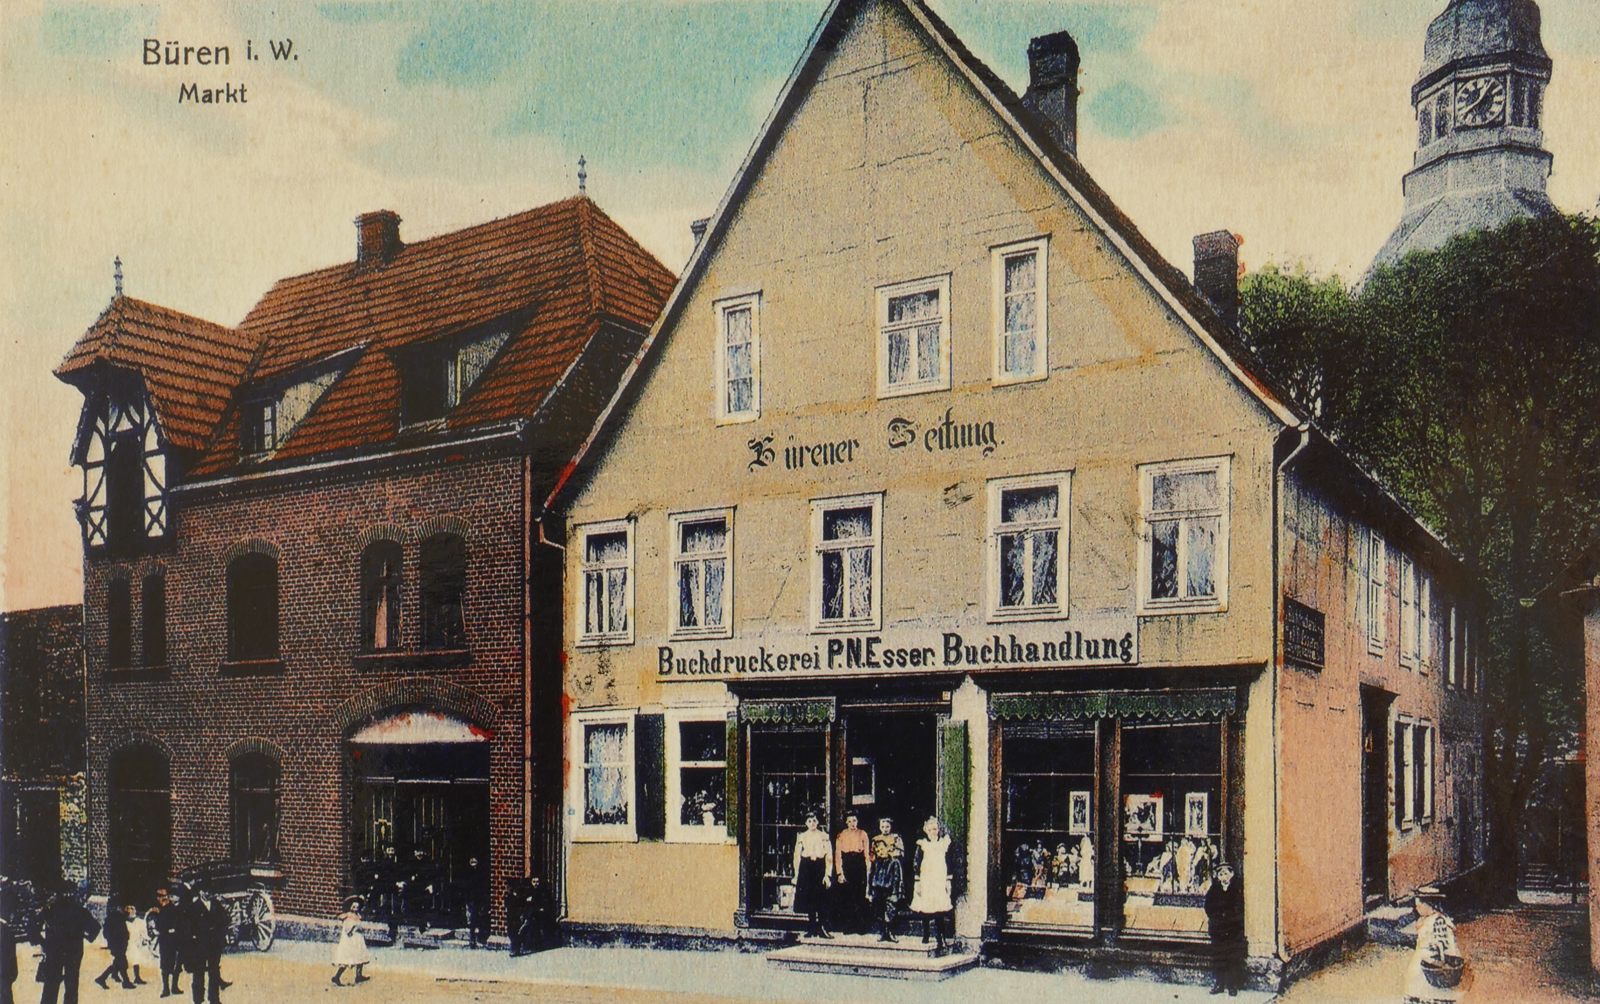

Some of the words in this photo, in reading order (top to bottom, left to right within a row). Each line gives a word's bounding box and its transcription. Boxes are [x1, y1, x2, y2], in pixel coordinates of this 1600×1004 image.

[748, 432, 860, 472] Bürener
[657, 645, 822, 676] Buchdruckerei
[941, 630, 1133, 667] Buchhandlung
